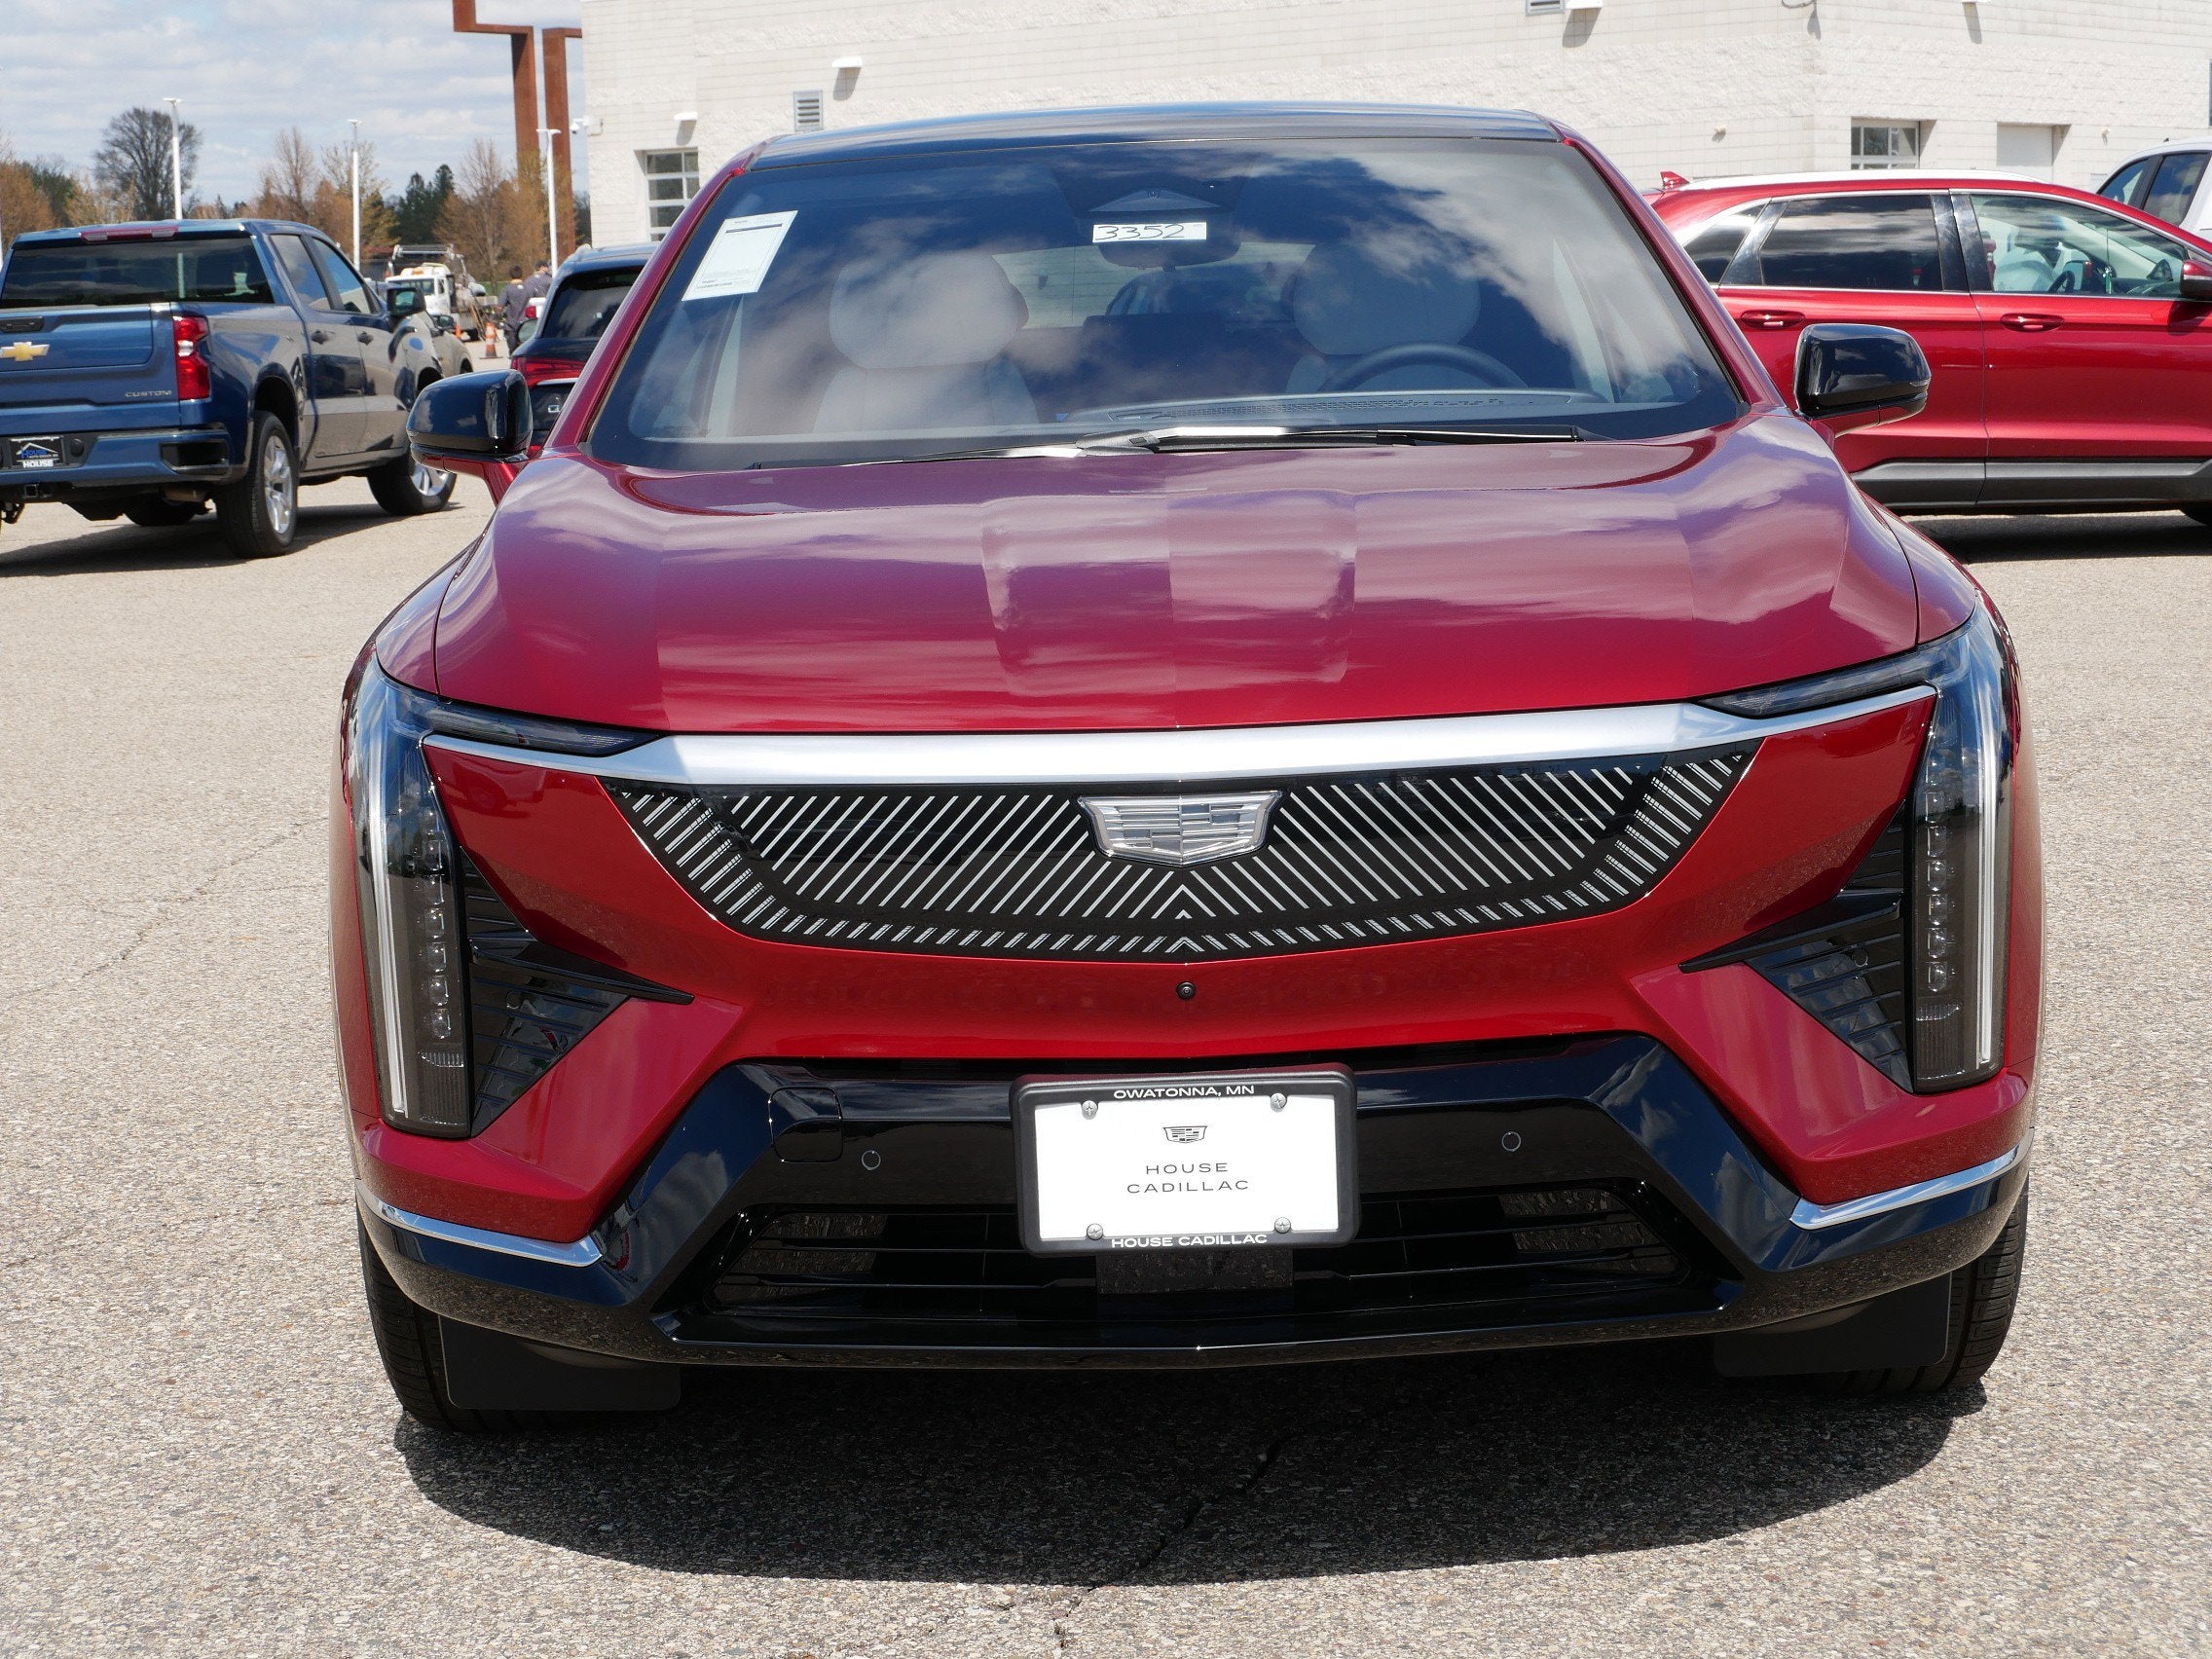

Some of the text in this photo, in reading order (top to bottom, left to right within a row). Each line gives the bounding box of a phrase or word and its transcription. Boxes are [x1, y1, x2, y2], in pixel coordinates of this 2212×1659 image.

[1095, 224, 1185, 240] 3352
[23, 460, 54, 468] HOUSE
[1113, 1085, 1255, 1099] OWATONNA, MN
[1146, 1162, 1229, 1175] HOUSE
[1126, 1180, 1248, 1194] CADILLAC
[1111, 1234, 1268, 1248] HOUSE CADILLAC
